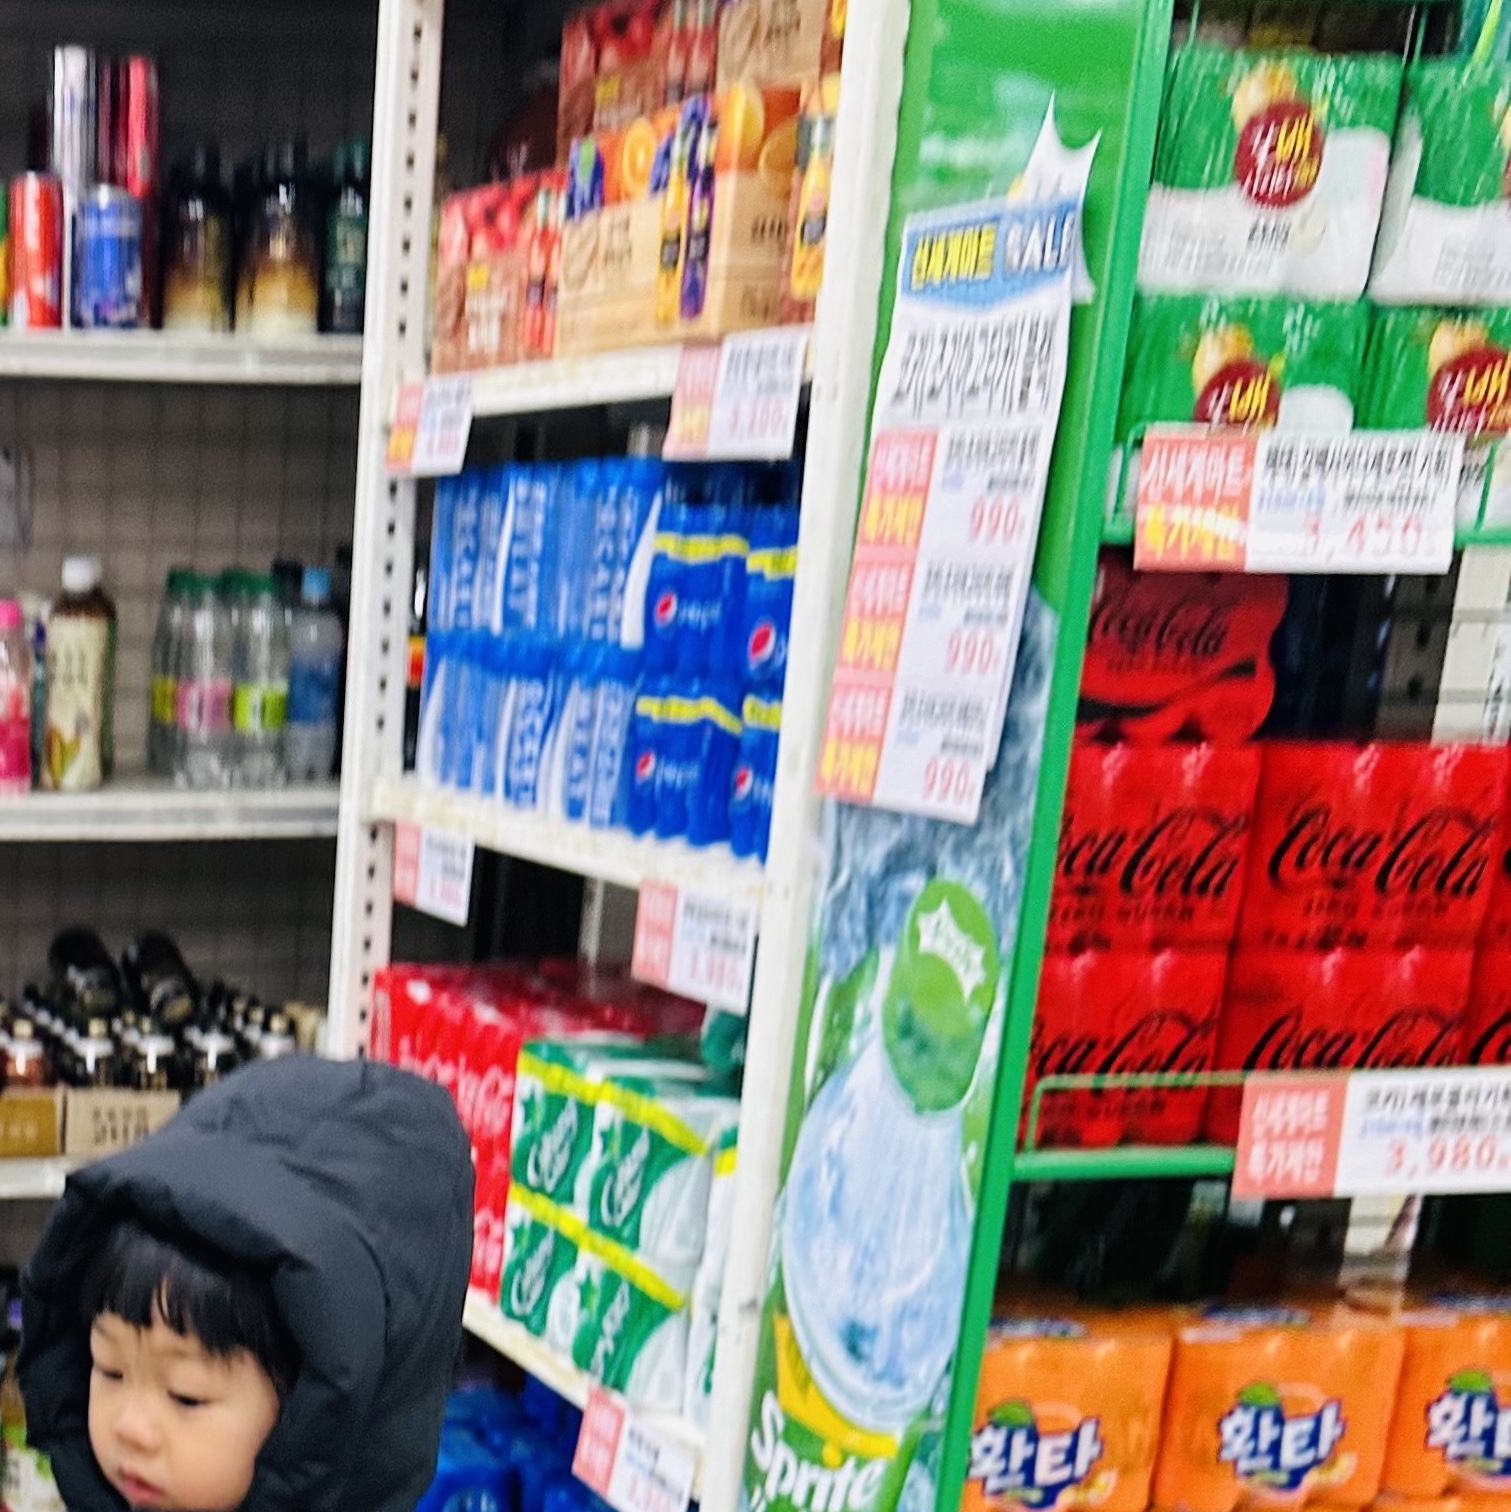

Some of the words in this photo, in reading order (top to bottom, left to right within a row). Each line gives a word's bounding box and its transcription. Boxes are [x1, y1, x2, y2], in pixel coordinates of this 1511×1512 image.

[971, 497, 1019, 542] 990
[946, 630, 996, 674] 990
[923, 758, 971, 798] 990
[1387, 1134, 1497, 1180] 3,980
[971, 1418, 1101, 1495] 환타
[1219, 1401, 1344, 1475] 환타
